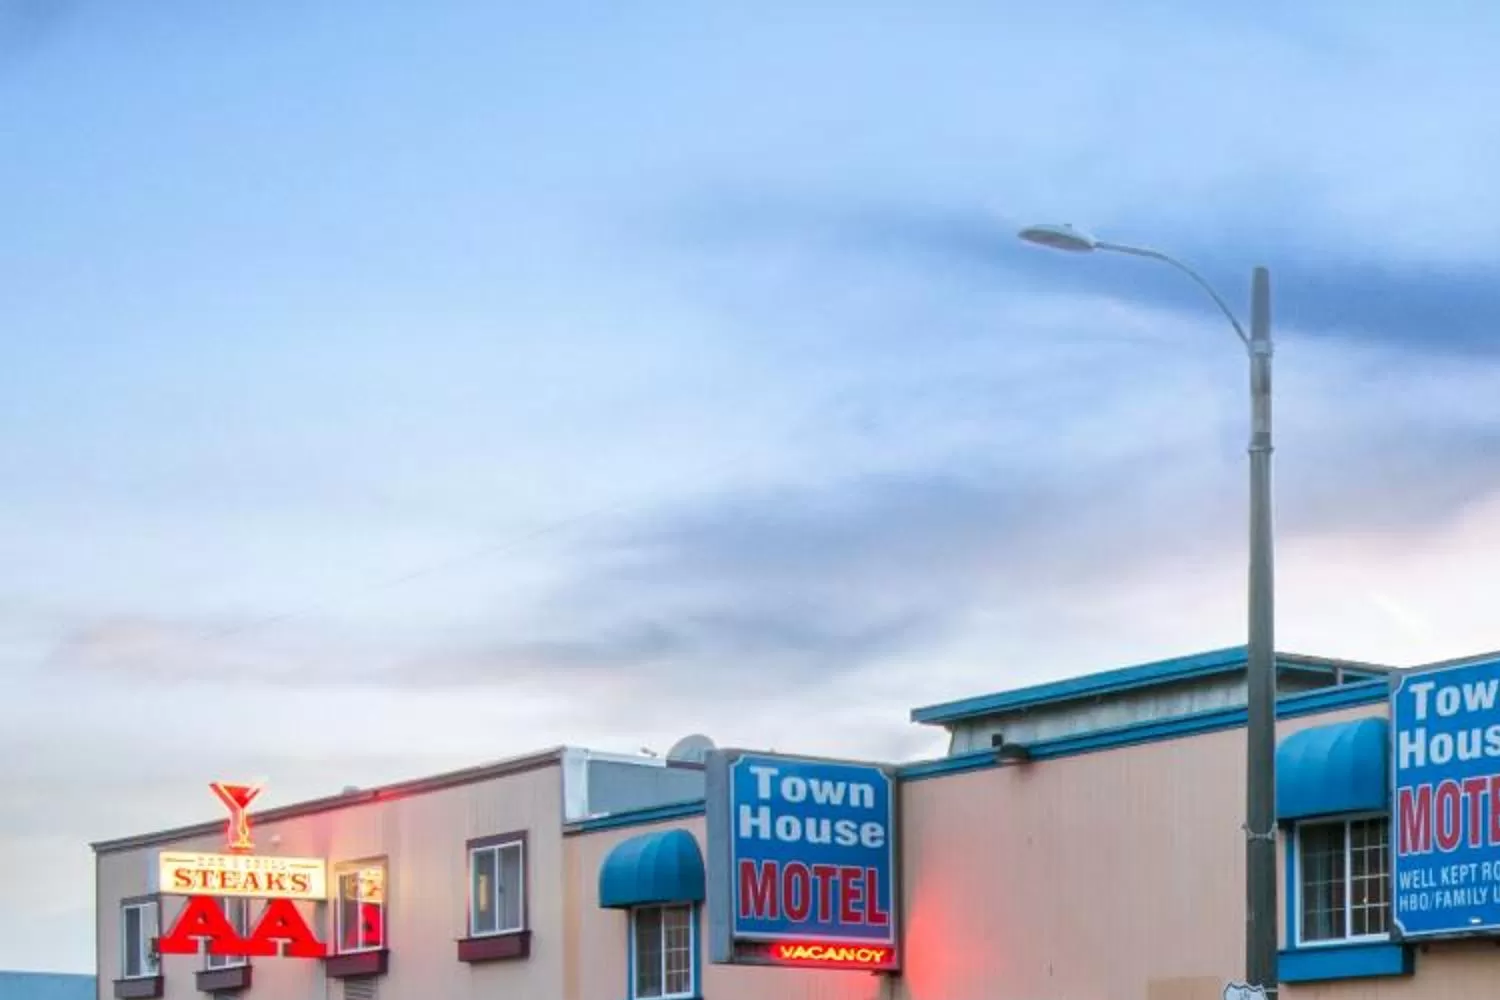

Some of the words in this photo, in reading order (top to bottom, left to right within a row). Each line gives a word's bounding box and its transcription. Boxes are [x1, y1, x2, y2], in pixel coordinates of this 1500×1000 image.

[749, 765, 875, 809] Town
[739, 804, 885, 849] House
[173, 867, 311, 893] STEAKS
[738, 857, 889, 926] MOTEL
[1400, 867, 1437, 890] WELL
[1440, 862, 1478, 886] KEPT
[1400, 886, 1488, 914] HBO/FAMILY
[159, 893, 327, 958] AA
